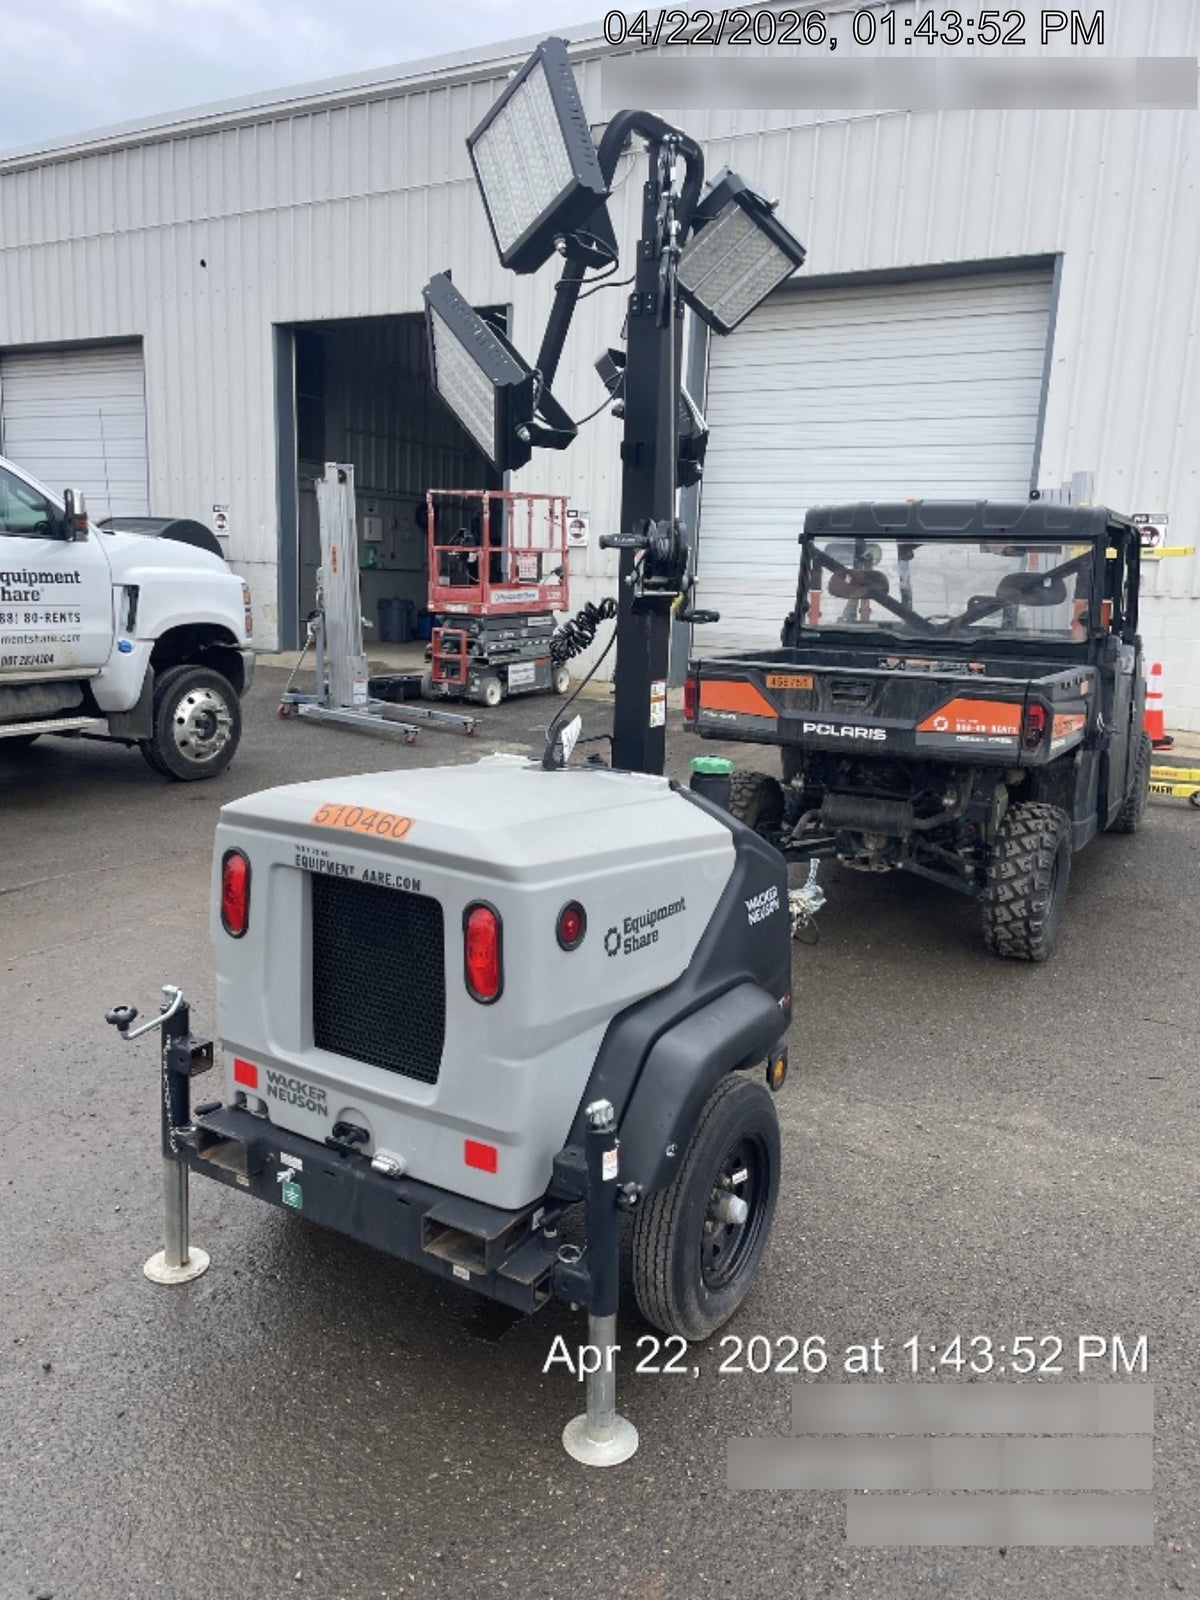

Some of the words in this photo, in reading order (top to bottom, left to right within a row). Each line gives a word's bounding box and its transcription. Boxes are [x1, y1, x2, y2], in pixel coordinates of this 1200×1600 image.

[803, 721, 887, 741] POLARIS
[314, 803, 412, 838] 510460
[623, 896, 686, 935] Equipment
[623, 930, 659, 955] Share
[266, 1069, 327, 1102] WACKER
[267, 1083, 328, 1118] NEUSON
